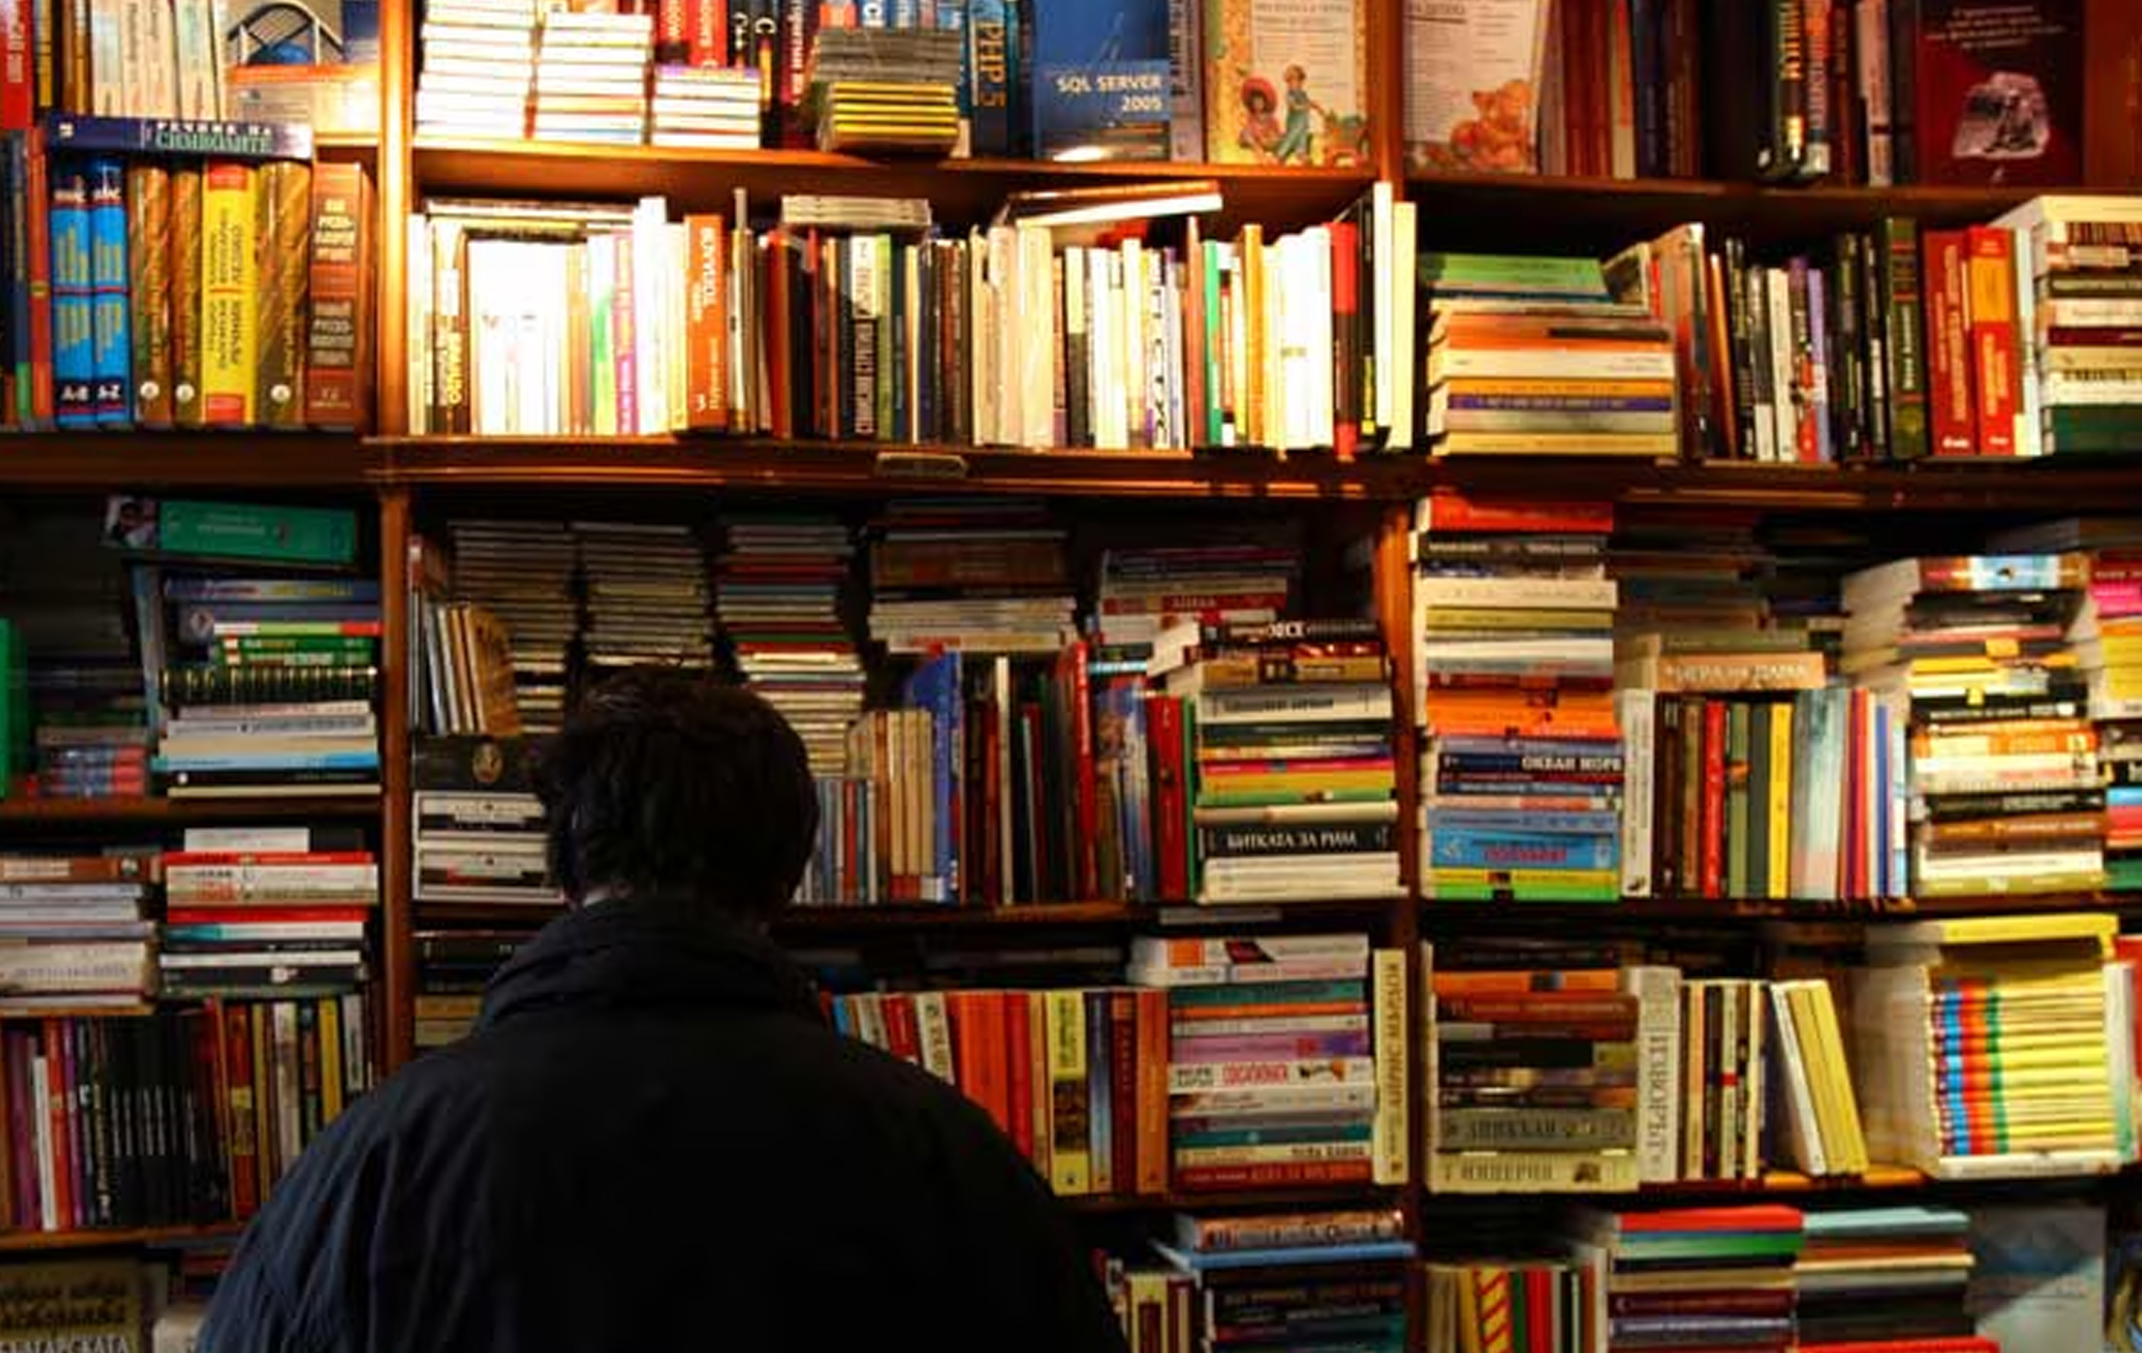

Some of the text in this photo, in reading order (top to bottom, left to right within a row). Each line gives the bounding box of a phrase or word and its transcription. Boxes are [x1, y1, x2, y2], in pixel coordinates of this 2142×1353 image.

[754, 15, 777, 35] C
[980, 22, 1005, 84] PHP
[1056, 73, 1162, 94] SQL SERVER
[1121, 95, 1162, 112] 2005
